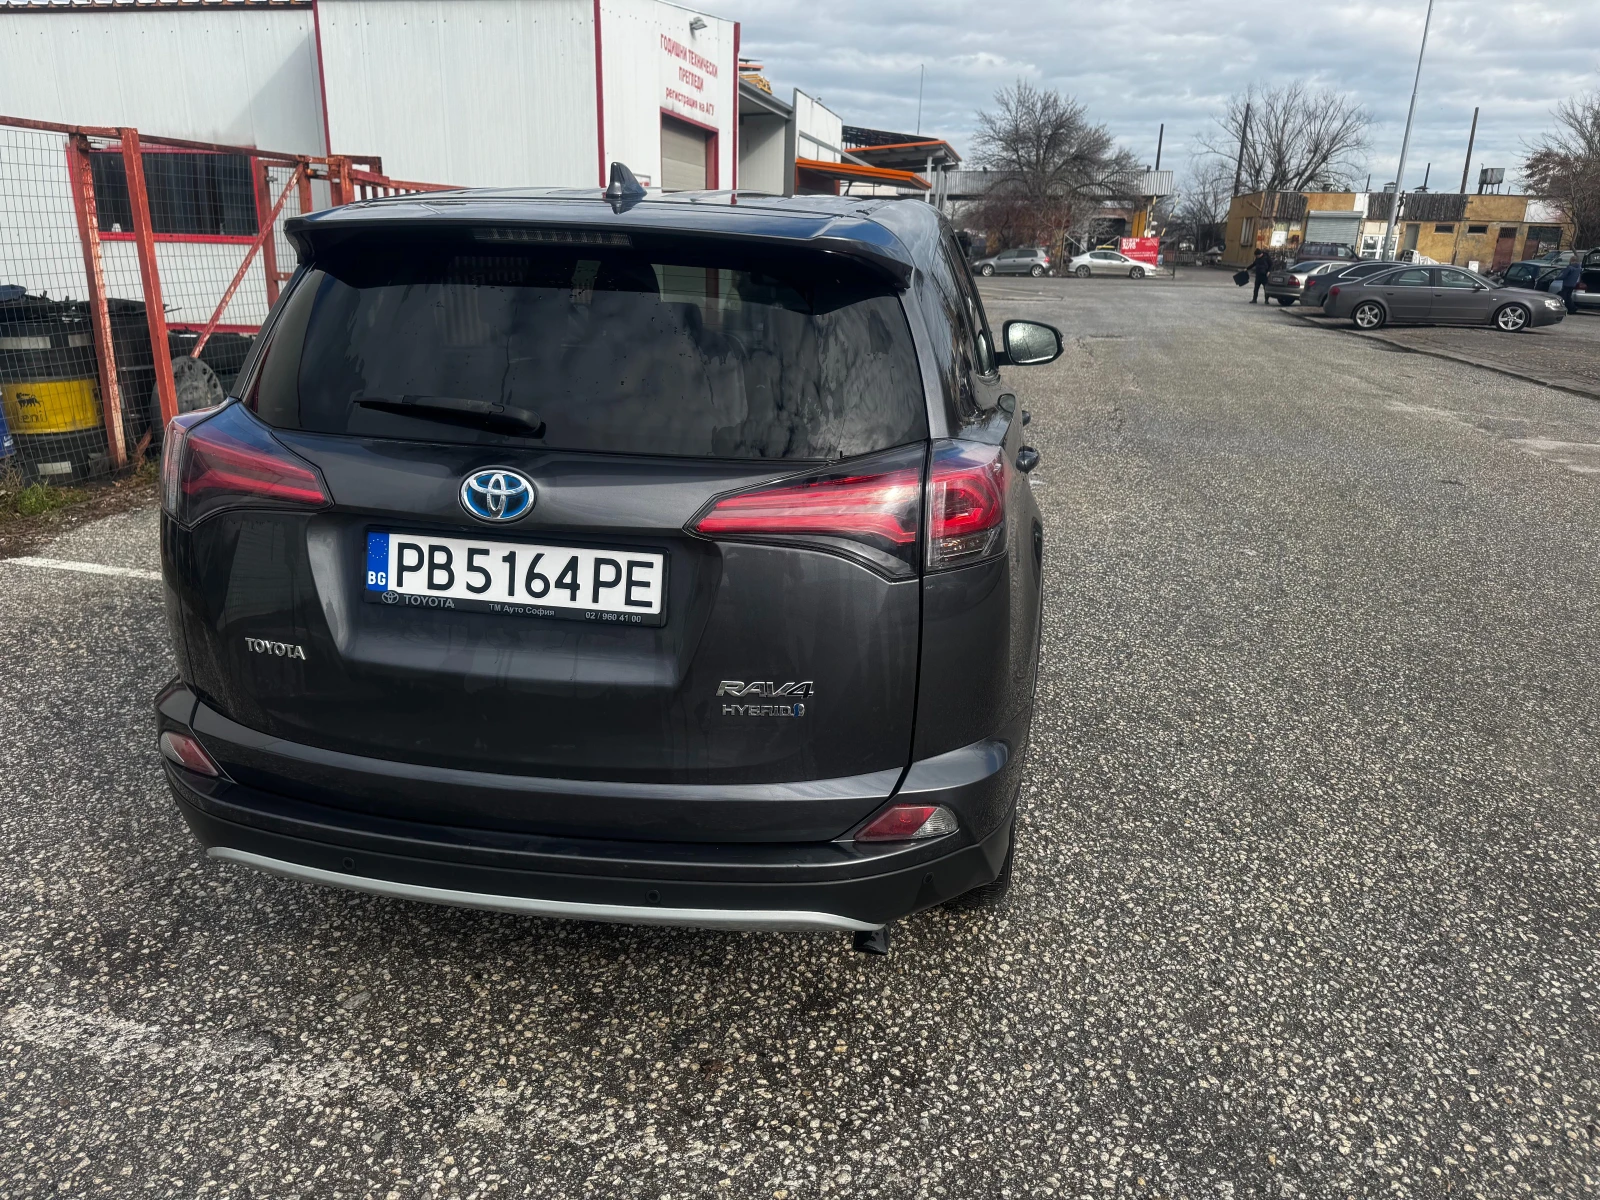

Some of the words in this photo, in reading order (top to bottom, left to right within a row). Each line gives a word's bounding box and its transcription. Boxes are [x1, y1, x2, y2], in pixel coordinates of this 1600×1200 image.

[660, 33, 687, 62] ГОДИШНИ
[688, 49, 718, 79] ТЕХНИЧЕСКИ
[22, 411, 43, 423] eni
[367, 570, 386, 586] BG
[403, 594, 455, 609] TOYOTA
[525, 606, 555, 617] София
[585, 611, 595, 620] 02
[602, 612, 617, 621] 960
[618, 614, 630, 622] 41
[631, 615, 642, 623] 00
[244, 637, 306, 660] TOYOTA
[715, 680, 815, 699] RAV4
[722, 704, 792, 716] HYBRID
